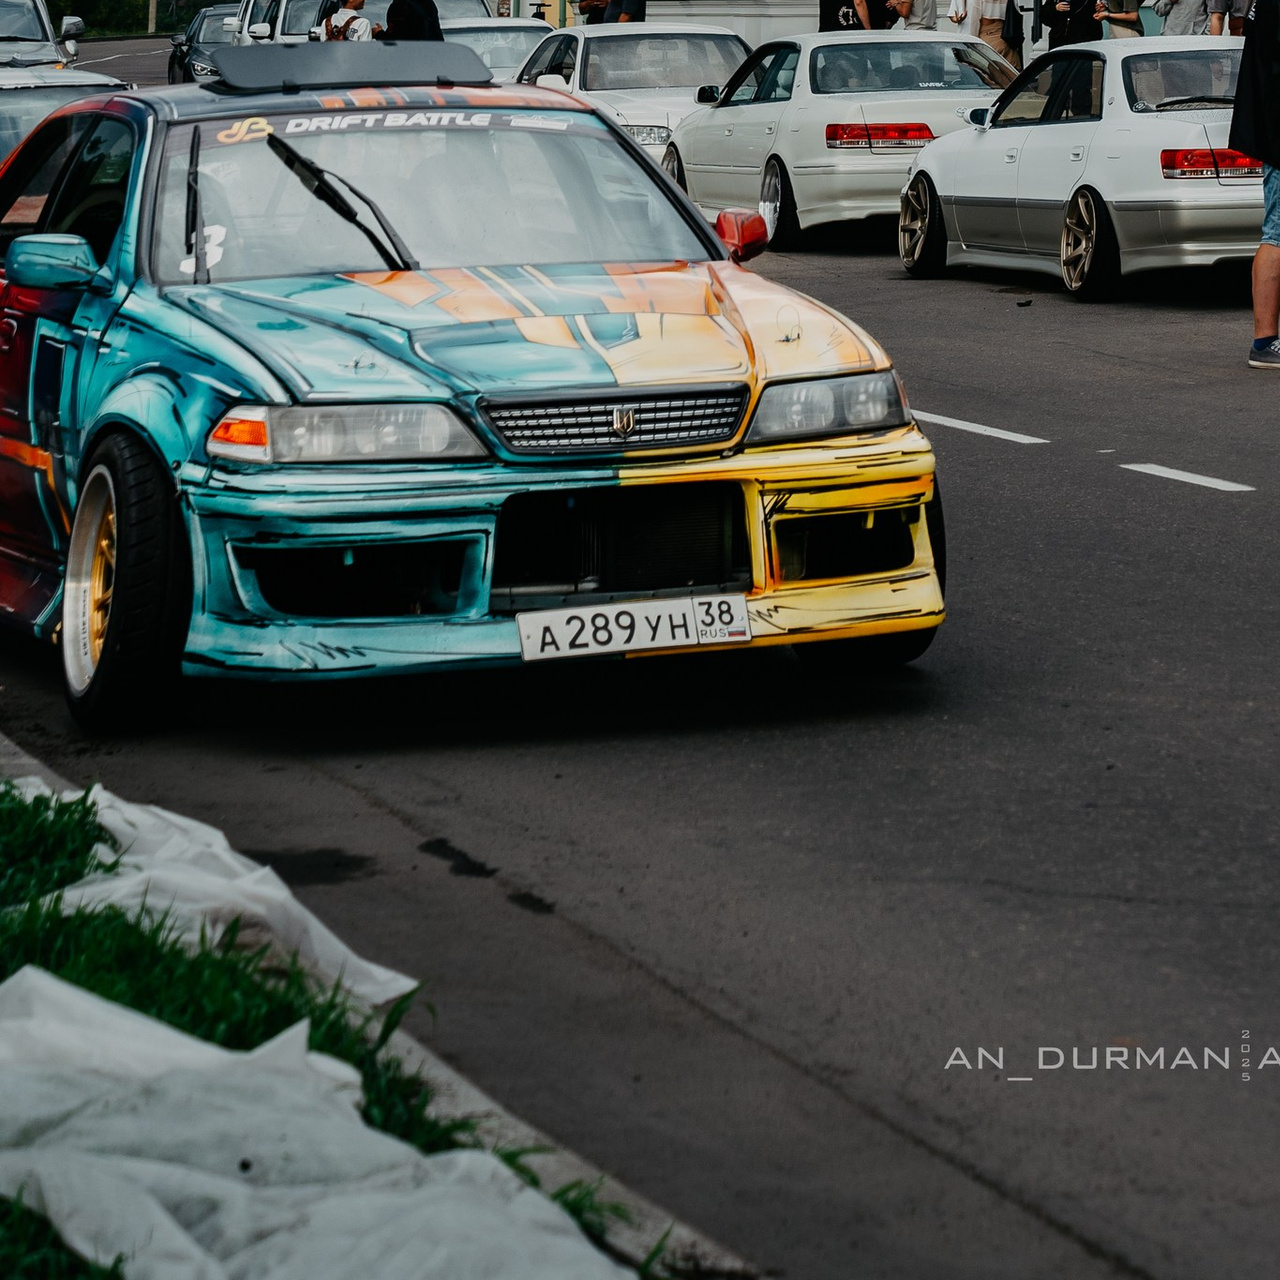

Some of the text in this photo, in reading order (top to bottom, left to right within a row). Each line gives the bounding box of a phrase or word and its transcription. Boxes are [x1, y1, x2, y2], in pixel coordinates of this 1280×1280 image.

[285, 113, 384, 134] DRIFT
[384, 112, 492, 128] BATTLE
[698, 600, 735, 627] 38
[700, 628, 727, 639] RUS
